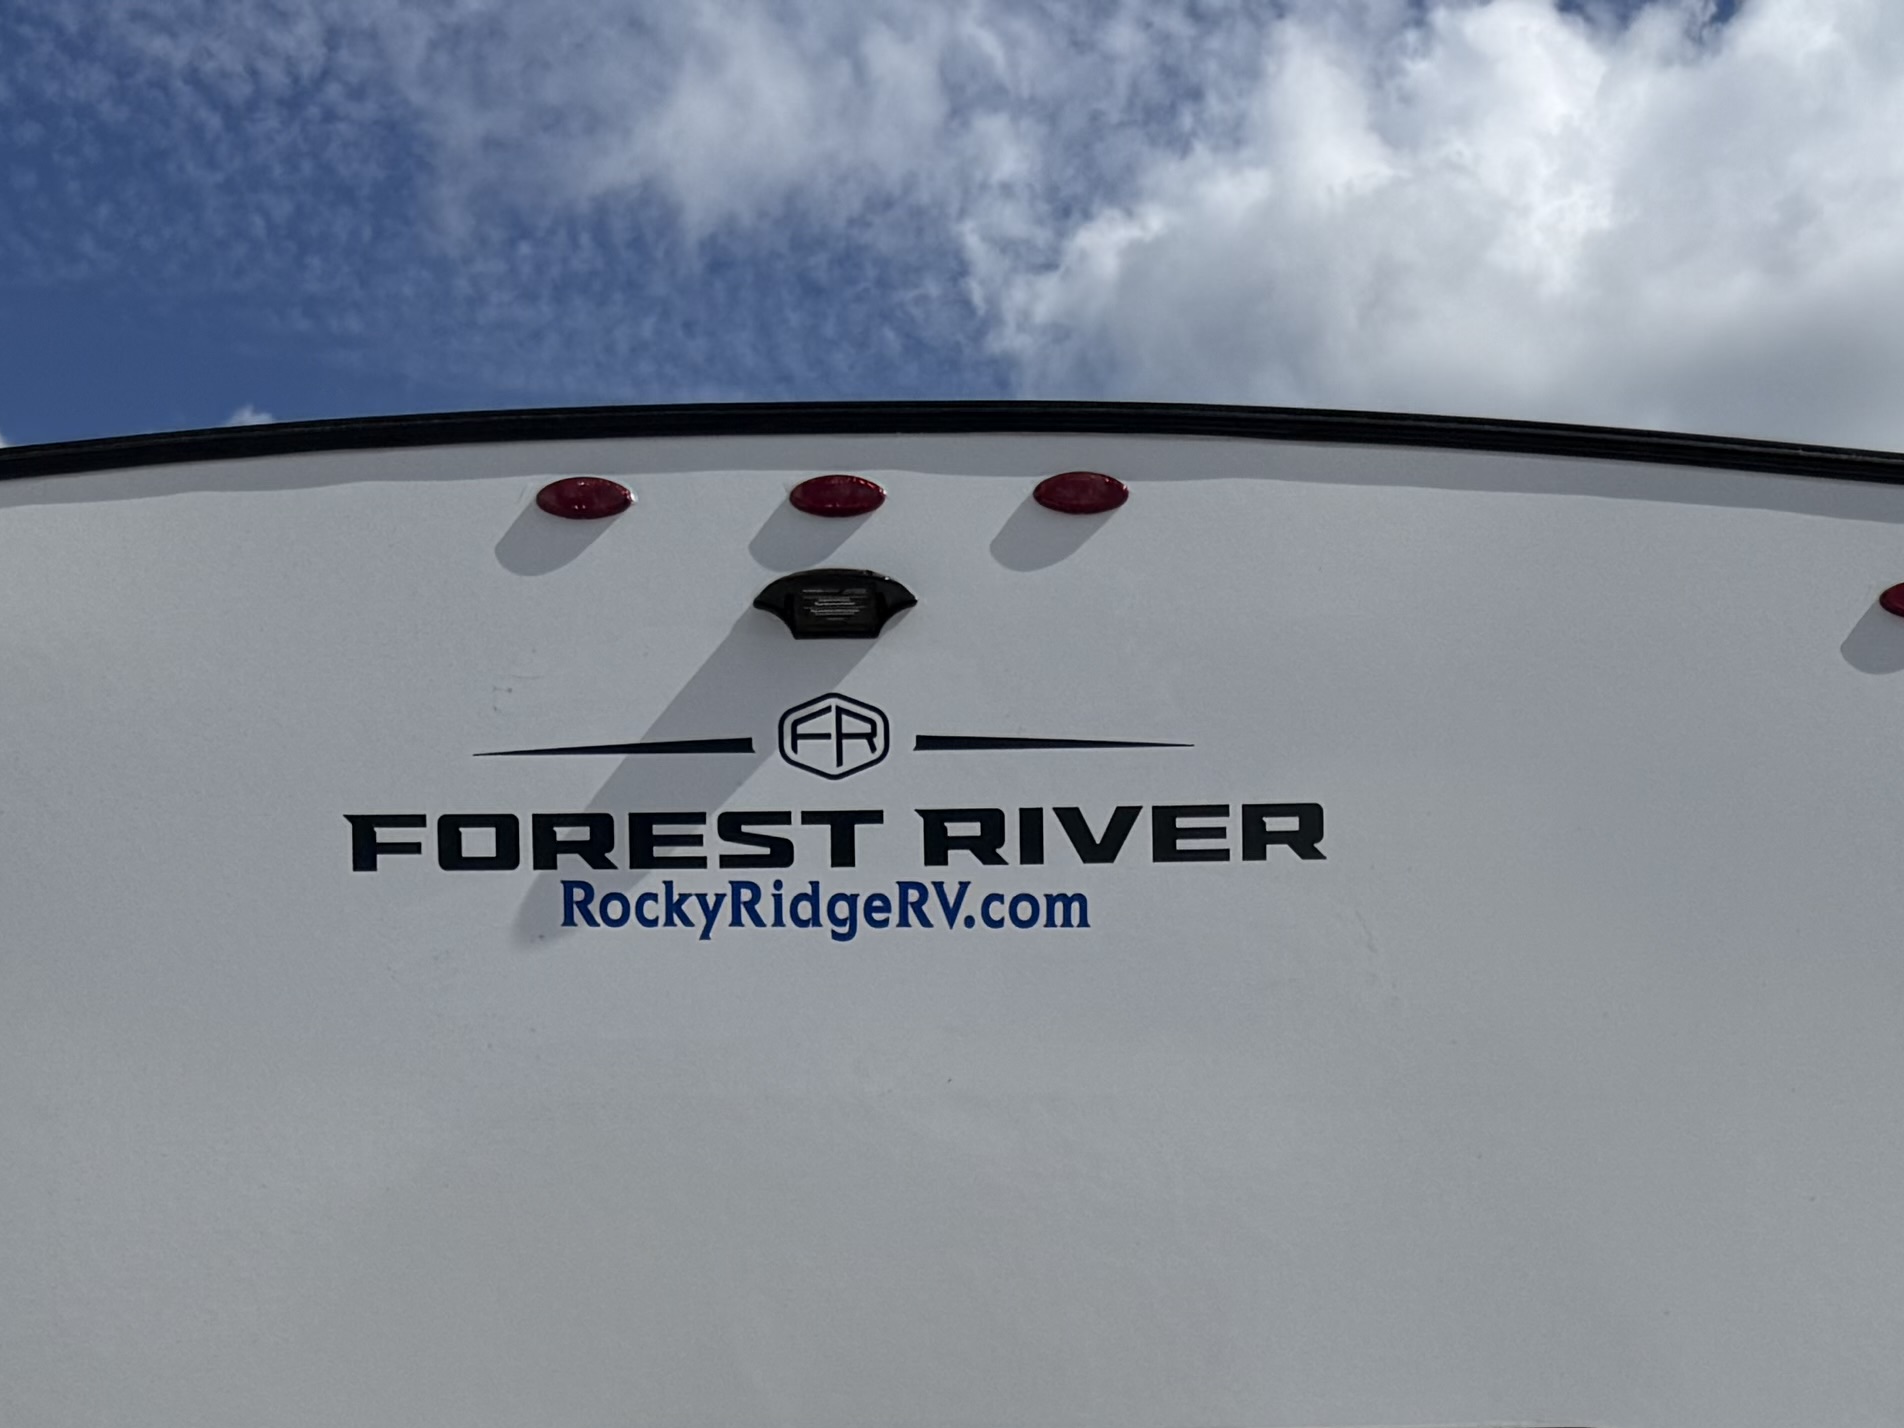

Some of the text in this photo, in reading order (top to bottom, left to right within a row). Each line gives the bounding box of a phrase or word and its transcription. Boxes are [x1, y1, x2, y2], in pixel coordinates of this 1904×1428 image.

[342, 802, 1327, 872] FOREST RIVER
[560, 879, 1090, 941] RockyRidgeRV.com
